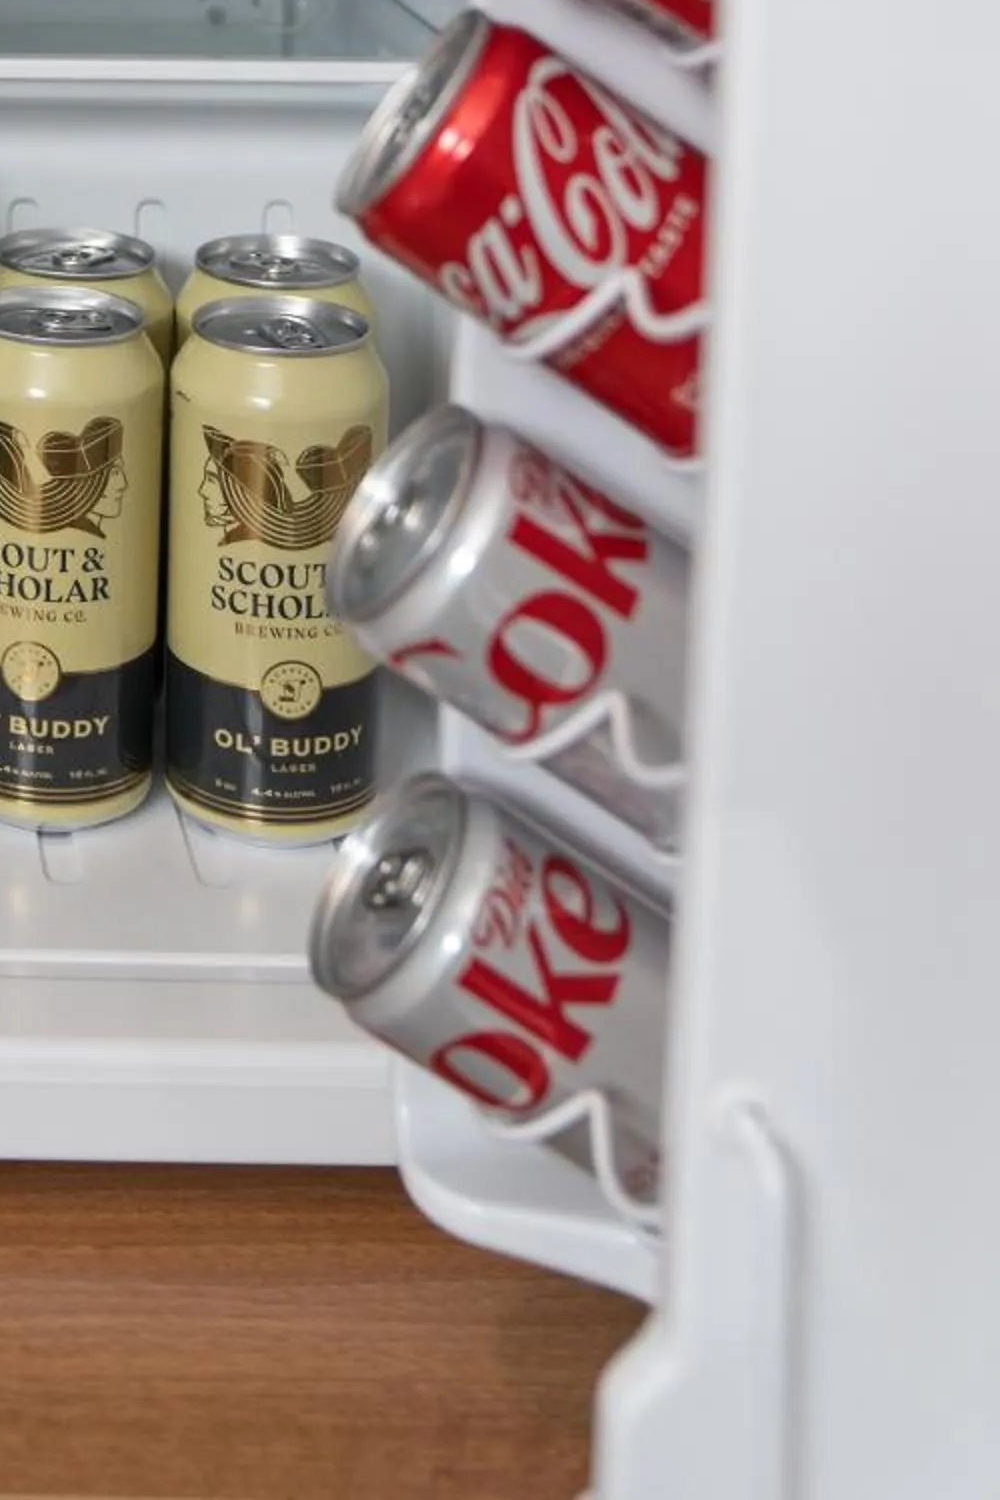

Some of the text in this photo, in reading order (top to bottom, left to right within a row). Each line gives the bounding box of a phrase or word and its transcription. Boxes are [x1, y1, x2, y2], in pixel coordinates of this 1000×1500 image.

[81, 546, 105, 573] &
[211, 584, 332, 621] SCHOL
[234, 621, 318, 640] BREWING
[9, 715, 110, 739] BUDDY
[8, 741, 55, 755] LAGER
[214, 723, 362, 758] OL' BUDDY
[271, 762, 317, 773] LAGER
[428, 851, 632, 1116] oke
